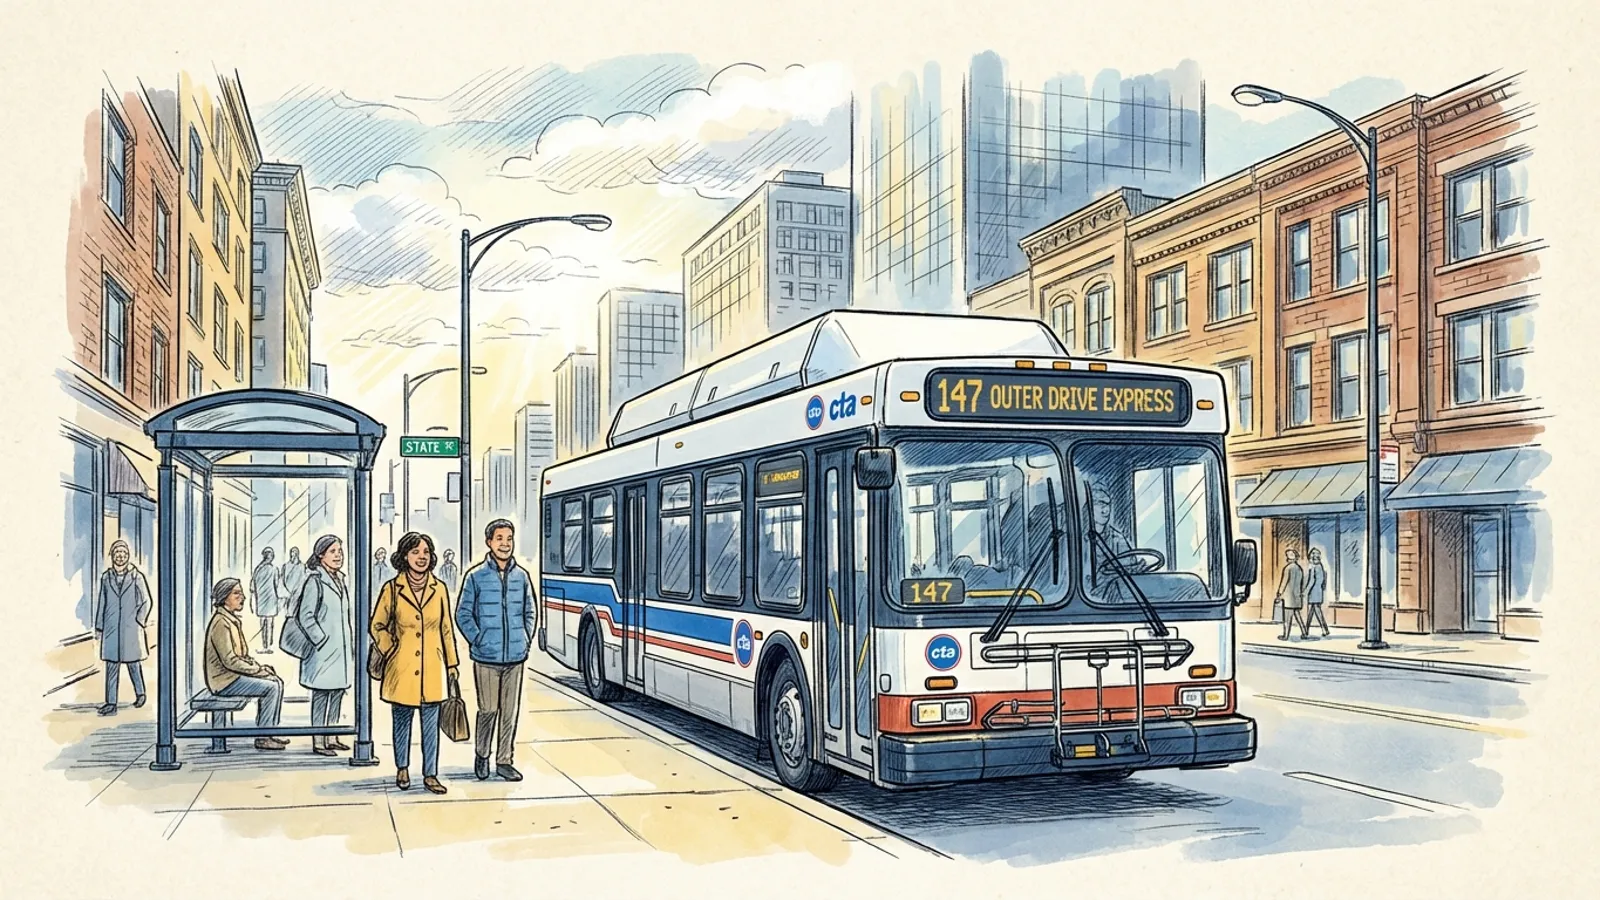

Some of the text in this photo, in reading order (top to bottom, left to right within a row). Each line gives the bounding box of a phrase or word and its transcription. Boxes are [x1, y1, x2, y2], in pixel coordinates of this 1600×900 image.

[829, 391, 857, 421] cta
[938, 378, 1175, 413] 147 OUTER DRIVE EXPRESS
[405, 441, 440, 453] STATE
[911, 581, 953, 603] 147
[931, 645, 956, 660] cta
